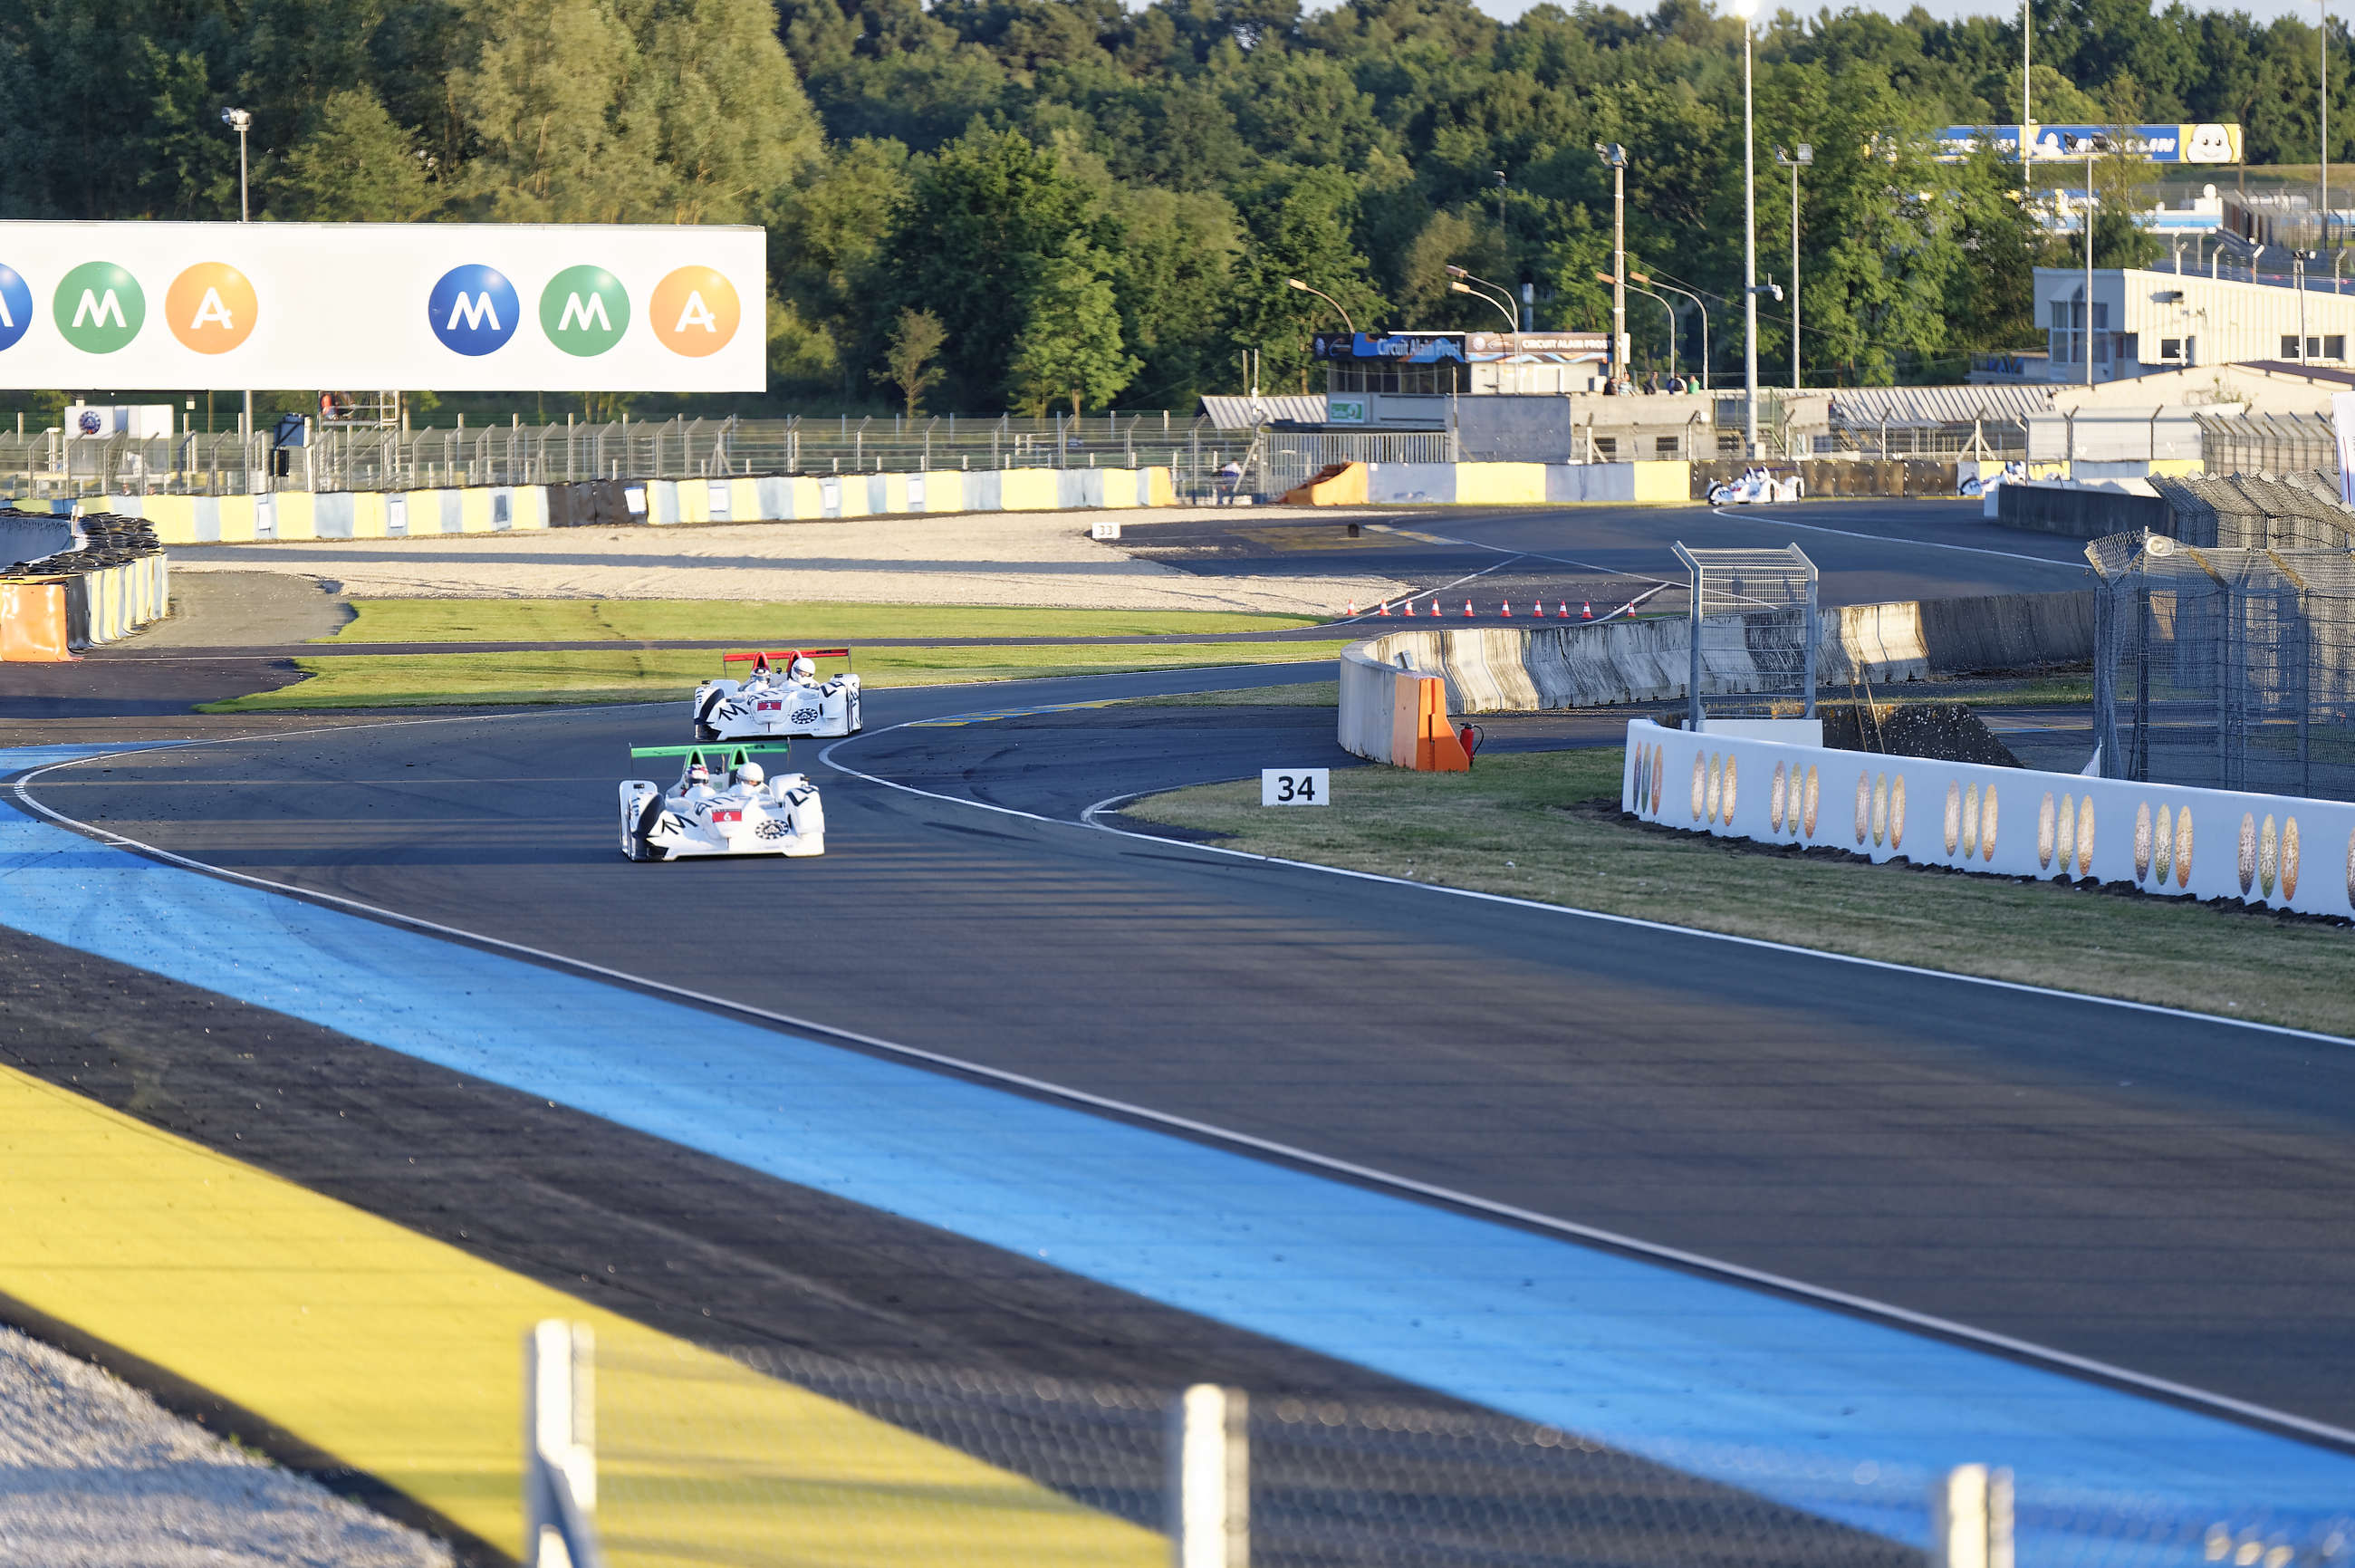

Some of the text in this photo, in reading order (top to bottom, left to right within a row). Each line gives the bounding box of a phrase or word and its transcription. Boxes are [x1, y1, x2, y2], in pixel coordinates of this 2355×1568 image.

[0, 286, 234, 329] MA
[1377, 338, 1461, 355] Circuit Alain Prost
[1522, 339, 1557, 349] CIRCUIT
[1558, 339, 1583, 349] ALAIN
[1099, 525, 1113, 535] 33
[765, 702, 773, 710] 1
[1277, 775, 1315, 802] 34
[723, 812, 733, 821] 6
